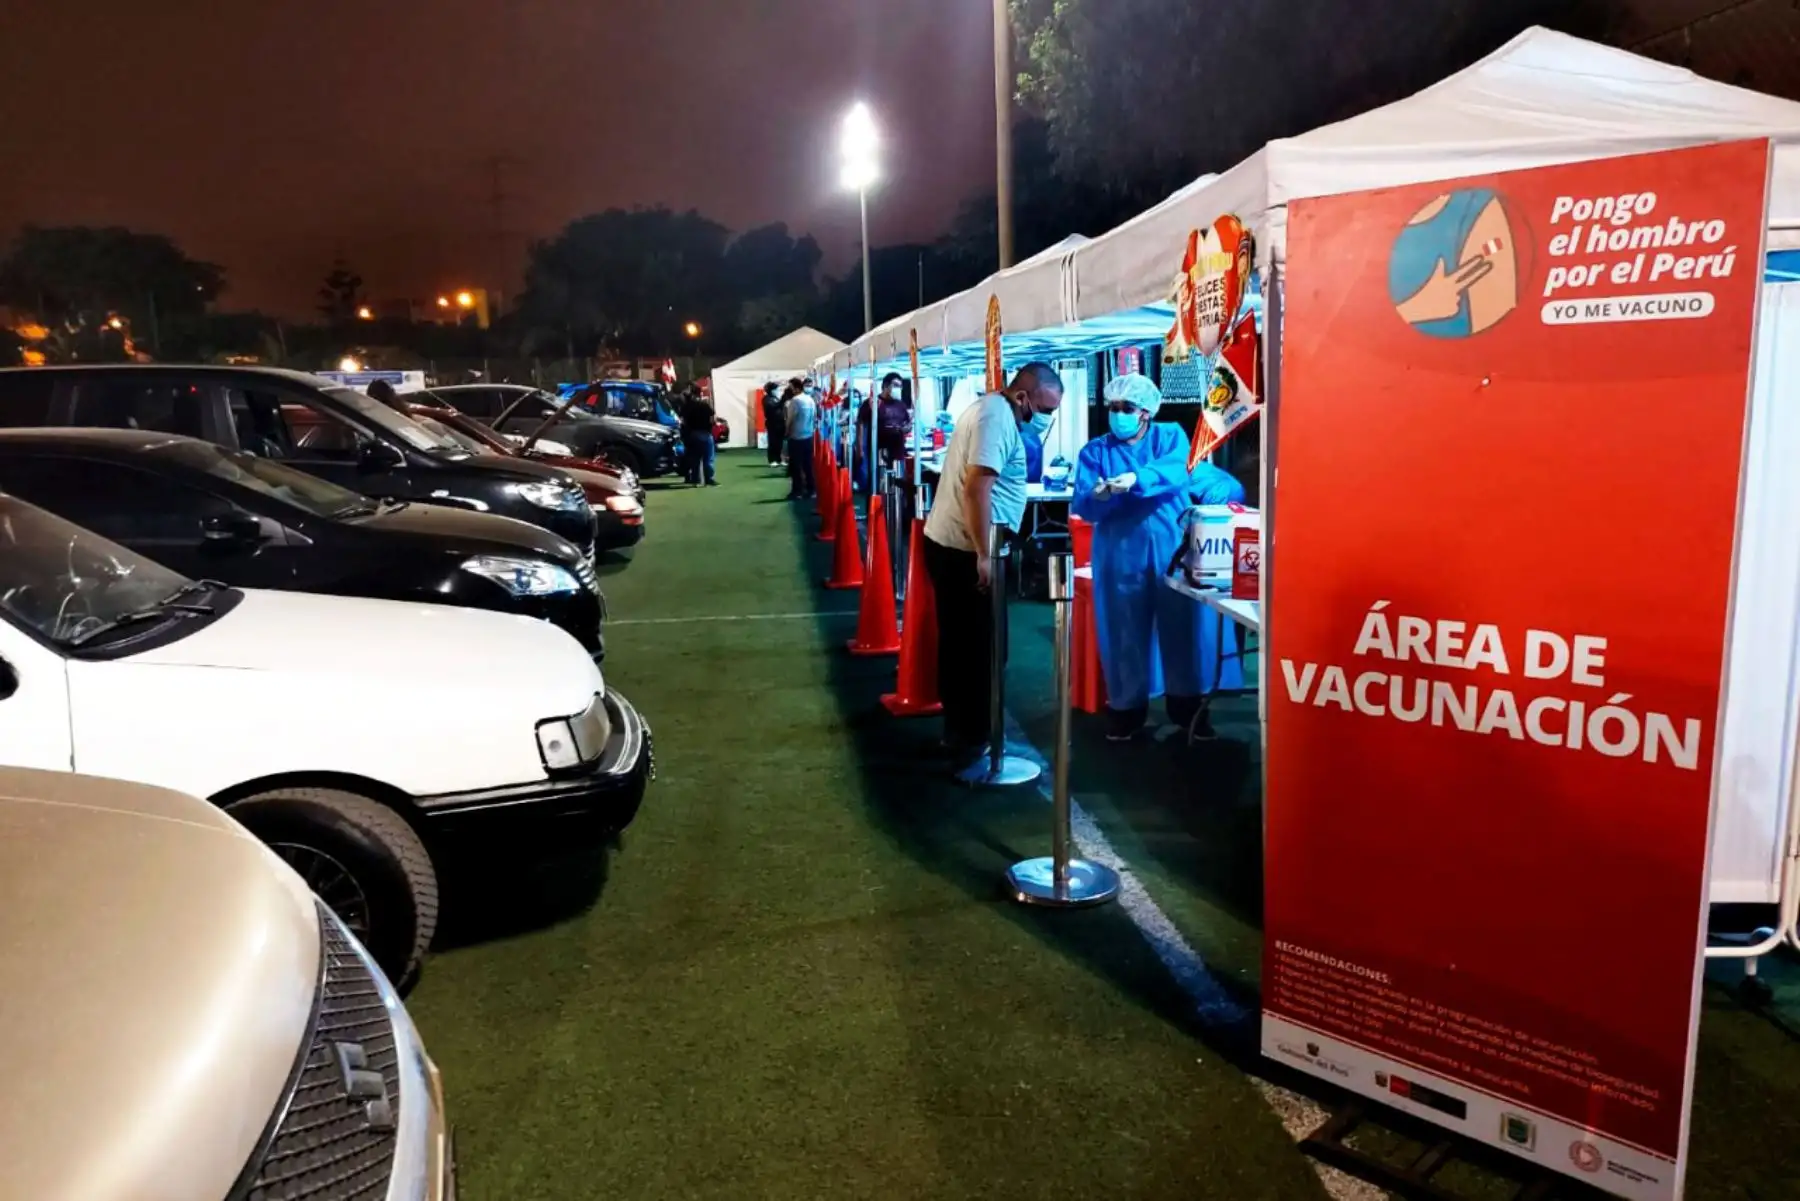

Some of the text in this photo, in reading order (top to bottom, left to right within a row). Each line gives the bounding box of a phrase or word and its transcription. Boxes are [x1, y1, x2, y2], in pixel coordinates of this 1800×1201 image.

[1550, 192, 1657, 226] Pongo
[1548, 217, 1726, 256] el hombro
[1543, 245, 1736, 297] por el Perú
[1552, 298, 1703, 319] YO ME VACUNO
[1353, 600, 1607, 687] ÁREA DE
[1280, 659, 1701, 770] VACUNACIÓN
